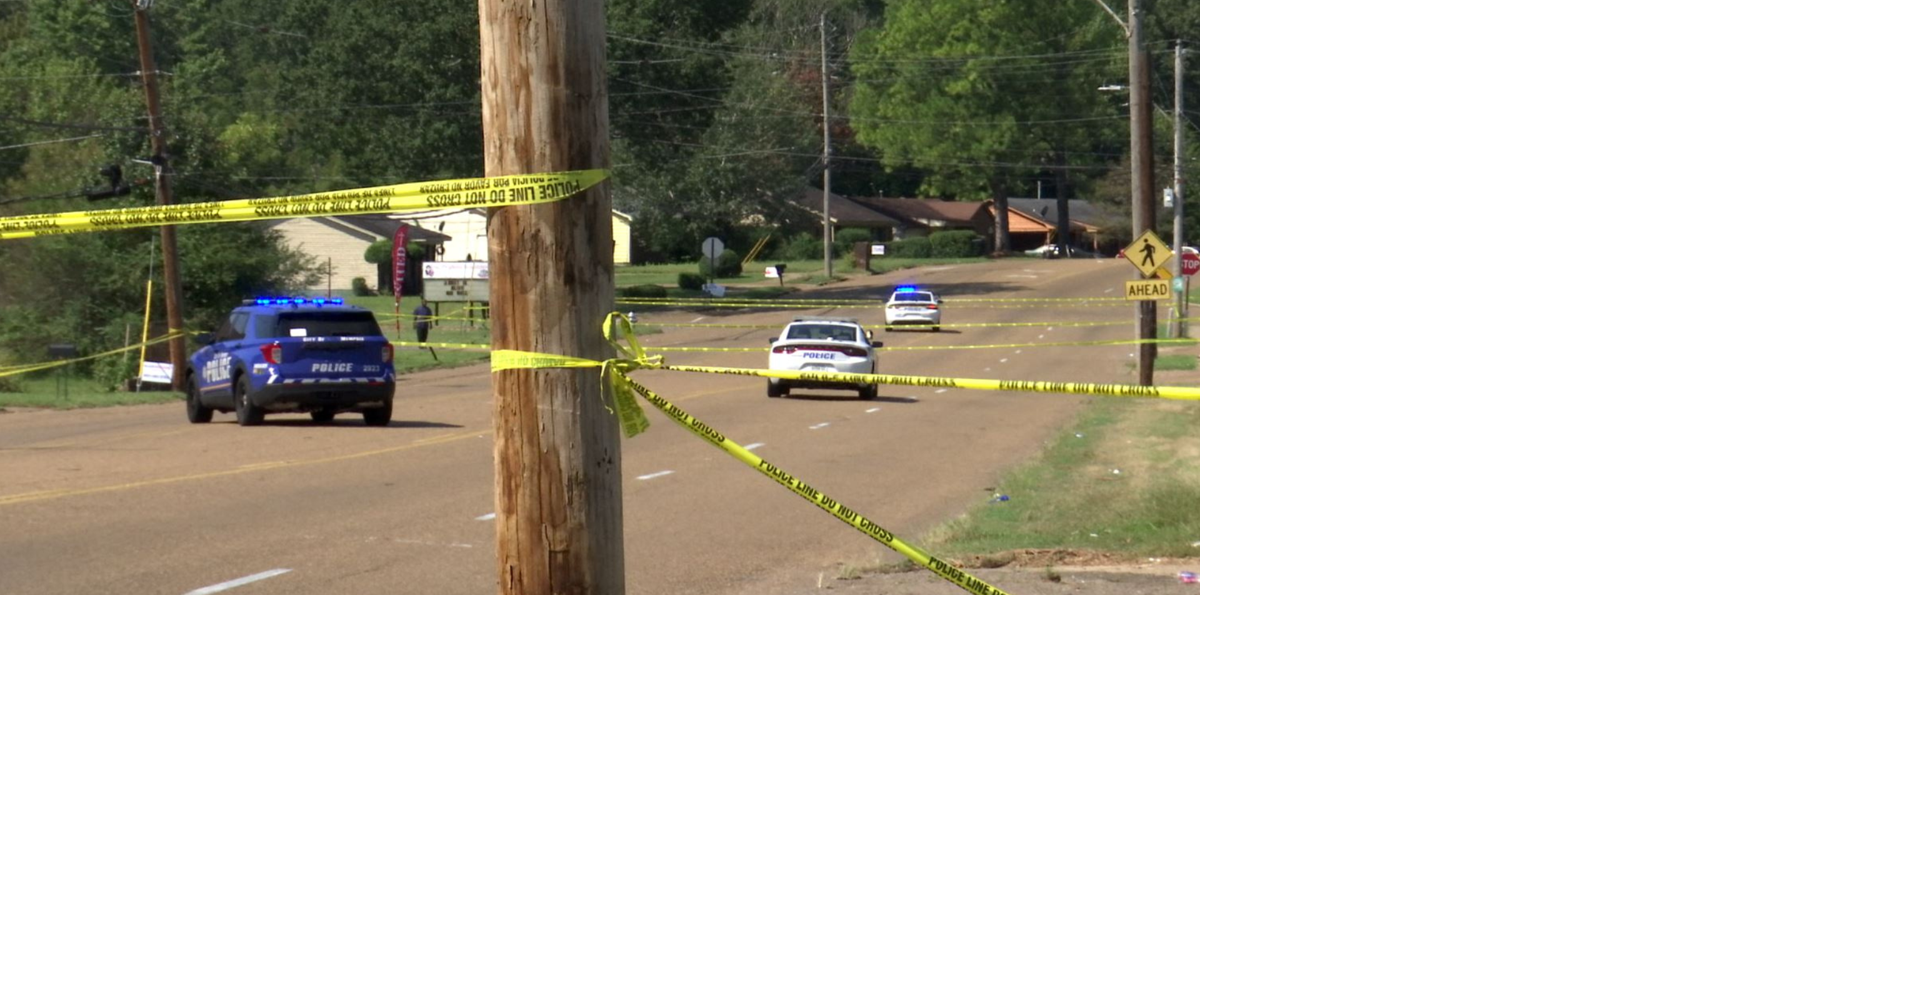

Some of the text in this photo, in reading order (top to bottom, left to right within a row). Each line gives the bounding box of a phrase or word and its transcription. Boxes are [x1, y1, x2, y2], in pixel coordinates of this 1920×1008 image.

[453, 183, 464, 192] NO
[465, 181, 490, 192] FAVOR
[493, 178, 509, 188] POR
[426, 180, 582, 208] POLICE LINE DO NOT CROSS
[356, 198, 391, 211] POLICE
[1181, 260, 1200, 269] TOP
[1129, 283, 1168, 296] AHEAD
[803, 351, 836, 360] POLICE
[311, 362, 354, 373] POLICE
[759, 459, 895, 543] POLICE LINE DO NOT CROSS
[928, 556, 965, 583] POLICE
[966, 576, 991, 595] LINE
